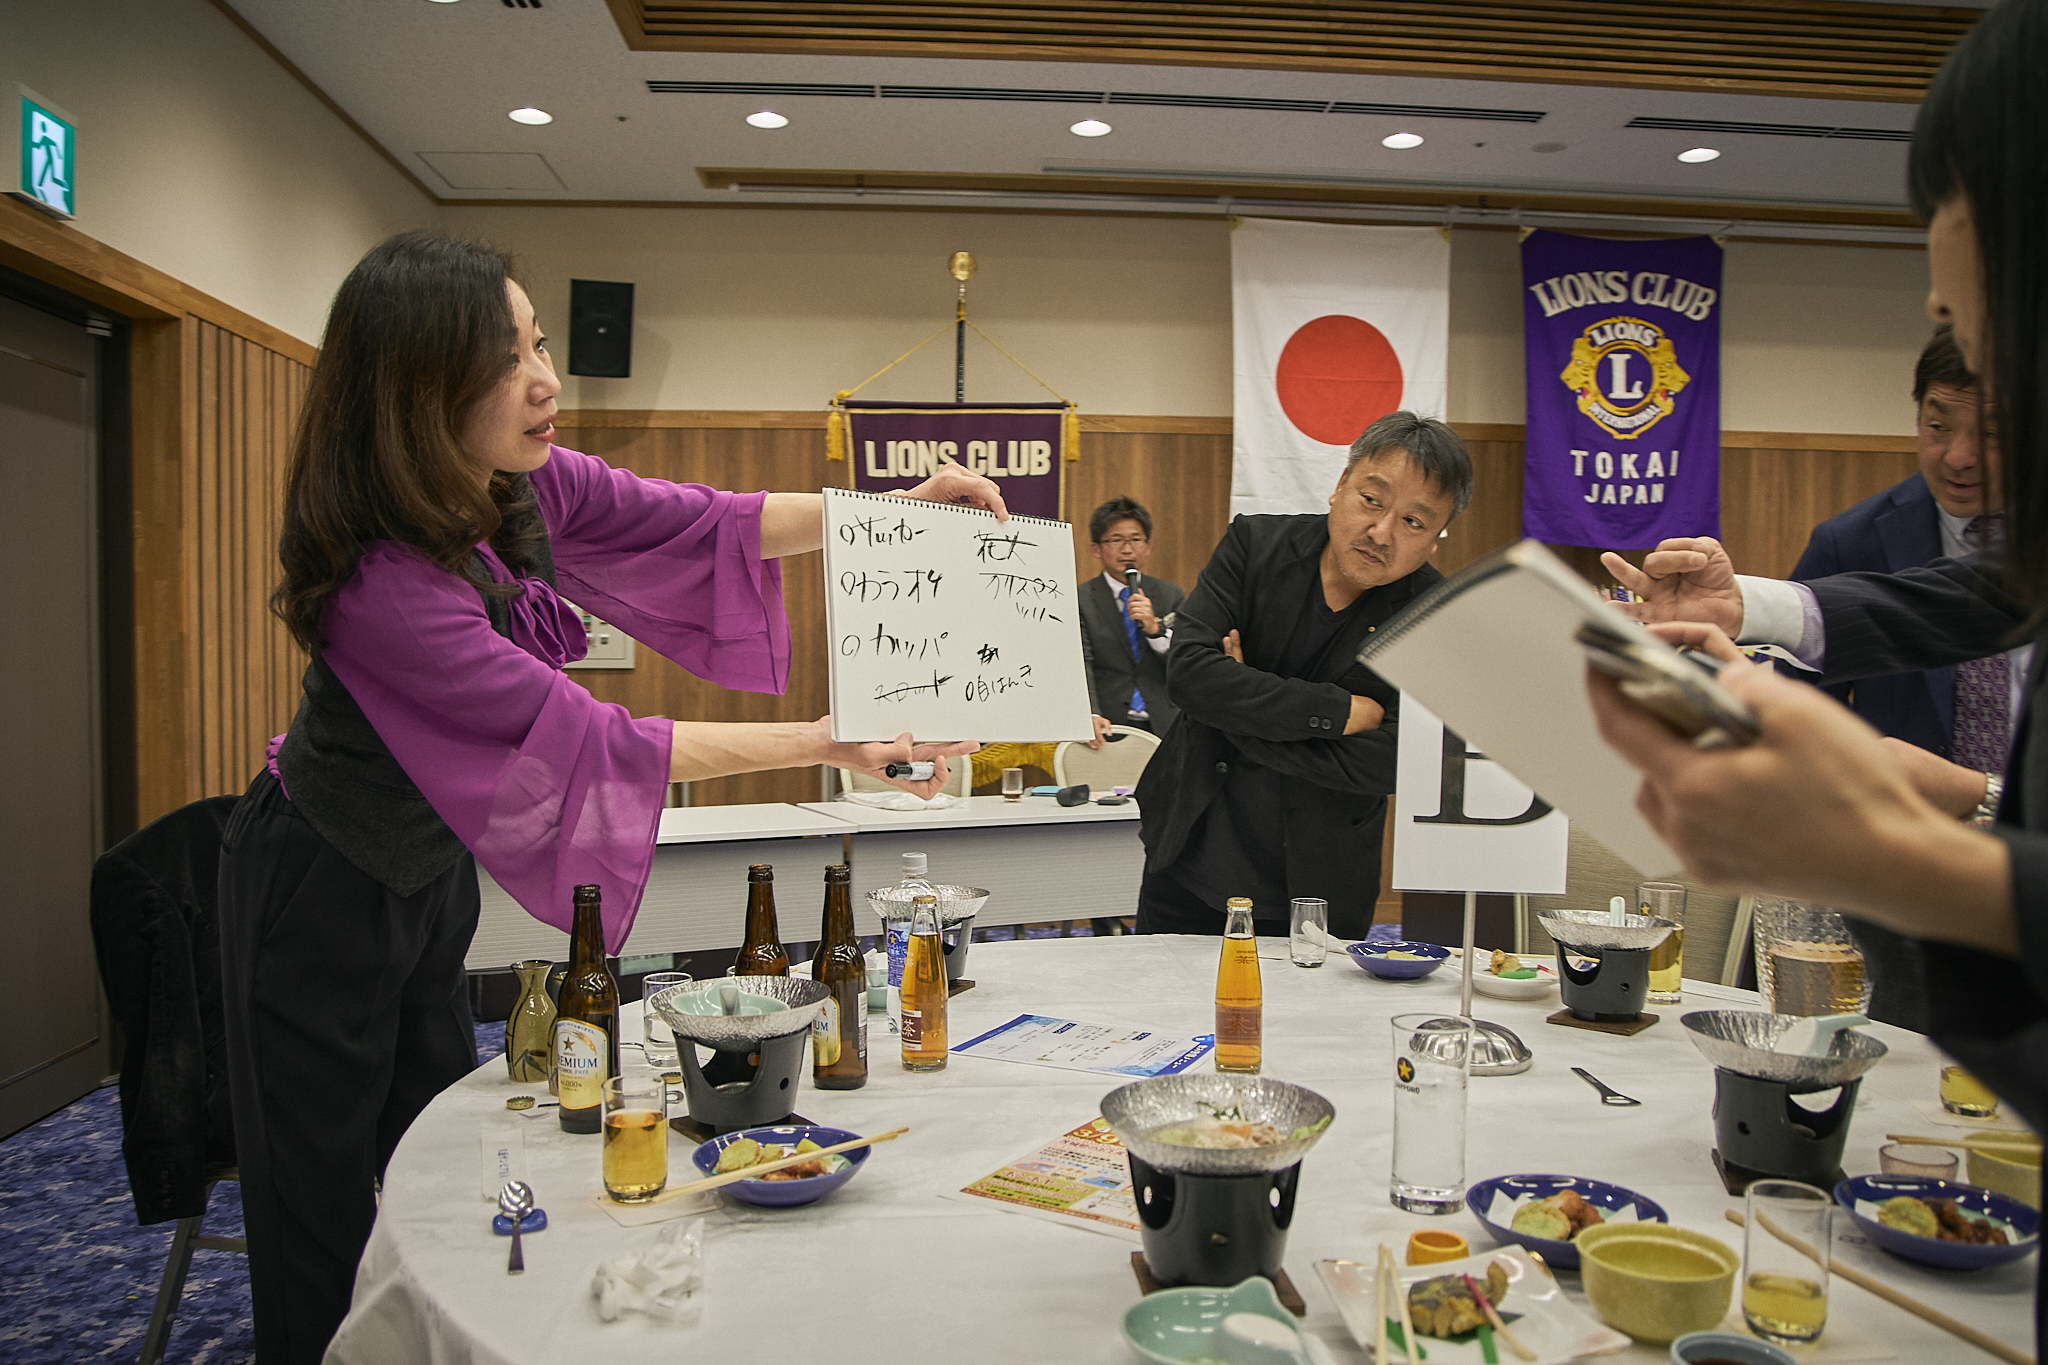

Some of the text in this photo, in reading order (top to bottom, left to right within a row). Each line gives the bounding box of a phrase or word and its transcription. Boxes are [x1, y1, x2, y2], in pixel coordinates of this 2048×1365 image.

[1529, 270, 1718, 322] LIONS CLUB
[1590, 322, 1659, 347] LIONS
[1607, 353, 1645, 400] L
[864, 440, 1052, 479] LIONS CLUB
[1570, 449, 1680, 480] TOKAI
[1583, 483, 1665, 505] JAPAN
[902, 1018, 917, 1038] 茶
[557, 1053, 598, 1069] REMIUM
[1073, 1129, 1124, 1145] 3/9
